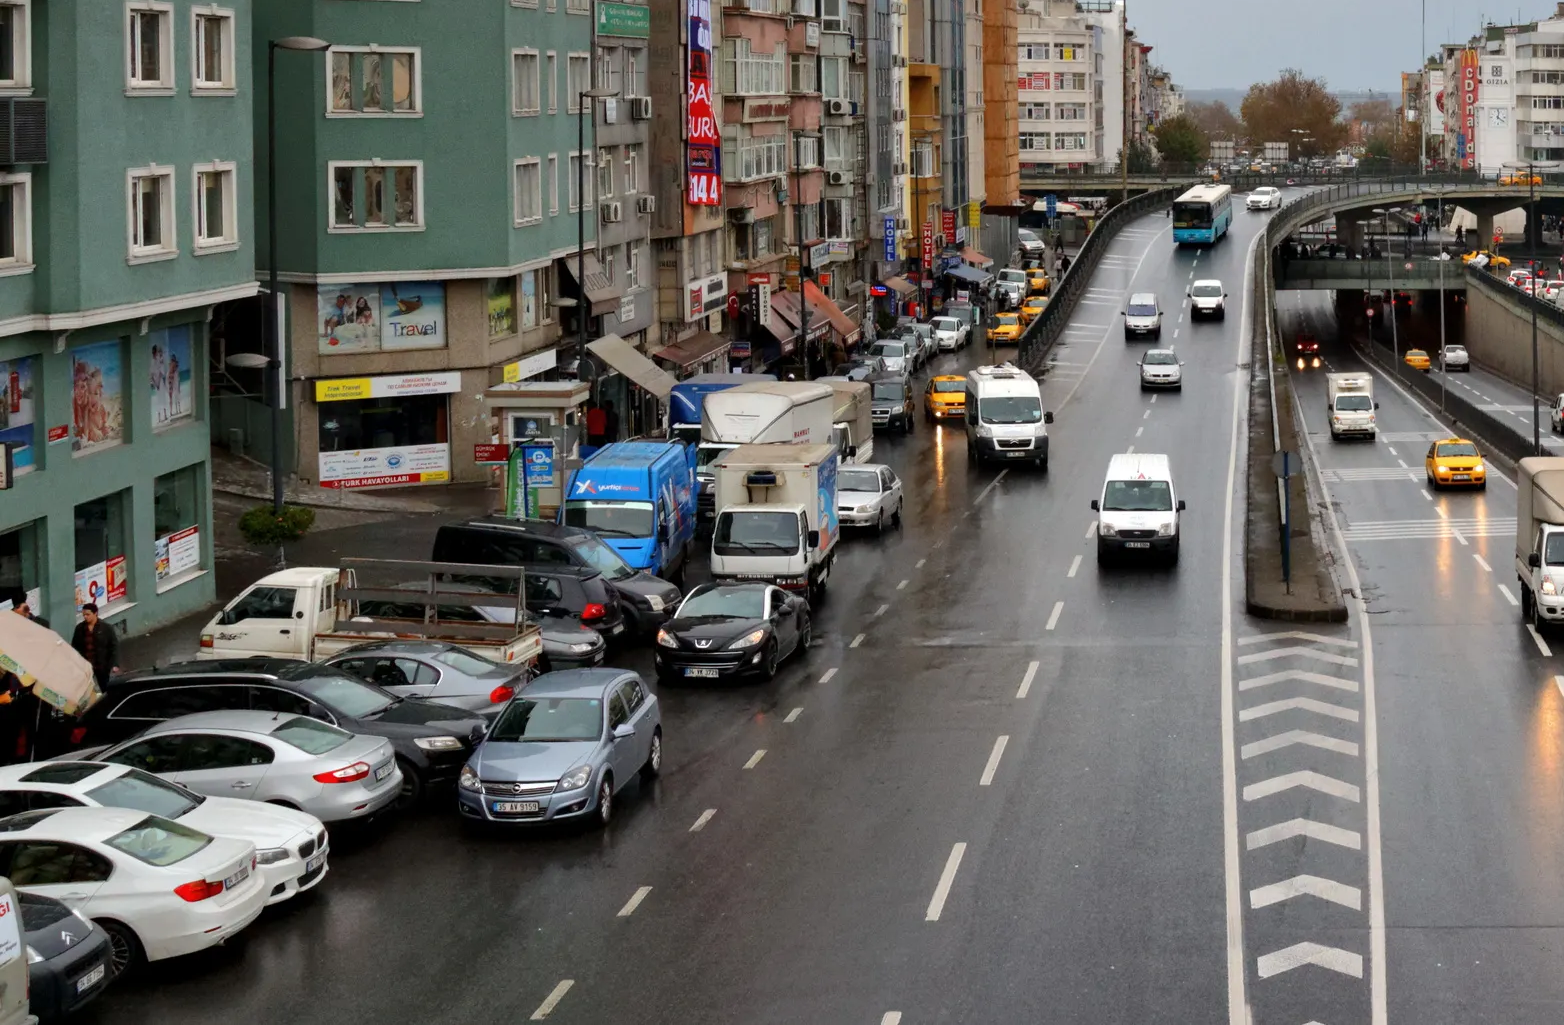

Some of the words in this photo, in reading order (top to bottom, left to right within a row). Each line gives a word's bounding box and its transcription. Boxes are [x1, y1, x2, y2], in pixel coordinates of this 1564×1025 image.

[886, 220, 894, 261] HOTEL
[389, 320, 437, 337] Travel
[361, 476, 410, 485] HAVAYOLLARI
[498, 803, 506, 811] 35
[510, 803, 518, 811] AV
[520, 803, 537, 811] 9159
